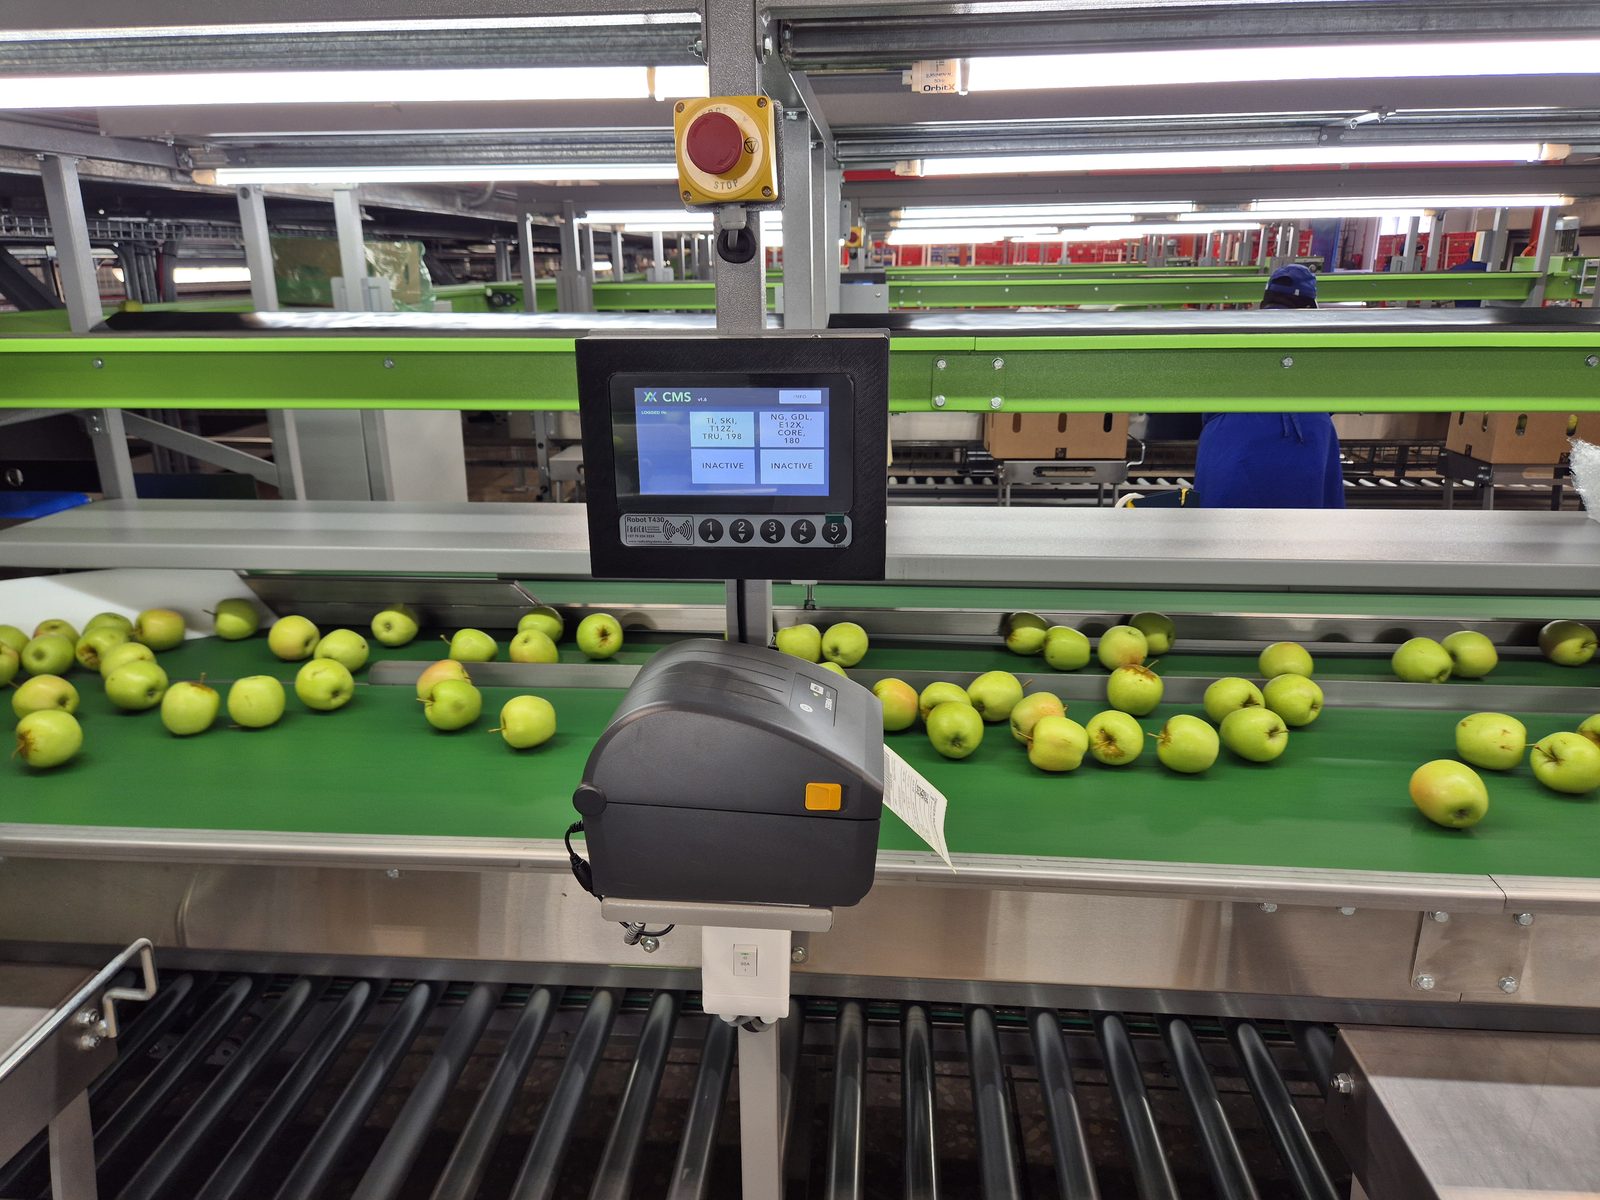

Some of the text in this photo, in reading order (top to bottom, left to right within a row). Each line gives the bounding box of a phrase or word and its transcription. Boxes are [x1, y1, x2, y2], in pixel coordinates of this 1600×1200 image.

[923, 84, 956, 92] OrbitX
[713, 179, 738, 190] STOP
[662, 391, 691, 402] CMS
[706, 417, 737, 425] TI, SKI,
[770, 413, 812, 421] NG, GDL,
[709, 425, 734, 433] T12Z,
[779, 421, 804, 429] E12X,
[702, 433, 723, 441] TRU,
[777, 429, 806, 437] CORE,
[702, 462, 744, 470] INACTIVE
[770, 462, 813, 470] INACTIVE
[707, 521, 714, 531] 1
[738, 521, 746, 532] 2
[769, 521, 776, 532] 3
[799, 521, 807, 532] 4
[830, 523, 838, 533] 5
